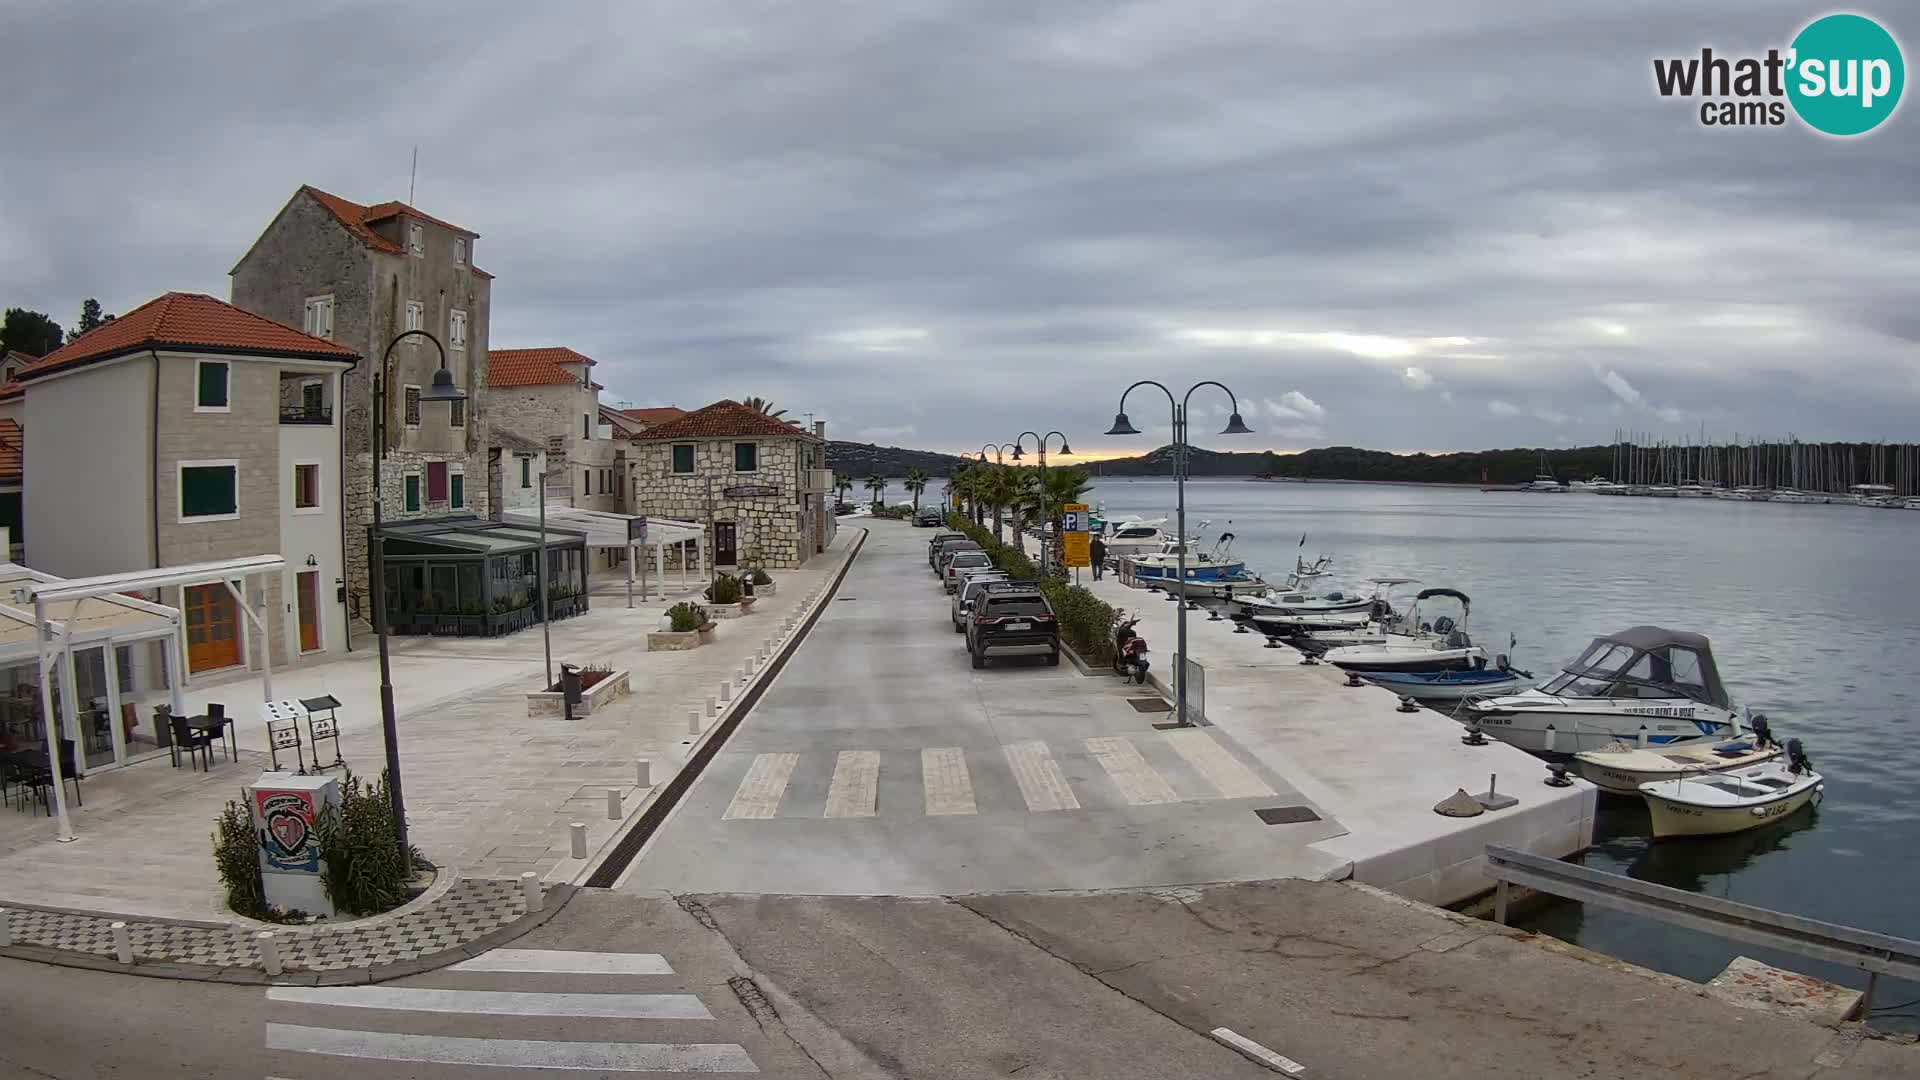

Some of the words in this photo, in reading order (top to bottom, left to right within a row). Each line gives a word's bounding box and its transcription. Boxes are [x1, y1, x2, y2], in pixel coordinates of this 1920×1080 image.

[1066, 514, 1076, 530] P
[1655, 707, 1672, 717] RENT
[1679, 708, 1696, 718] BOAT
